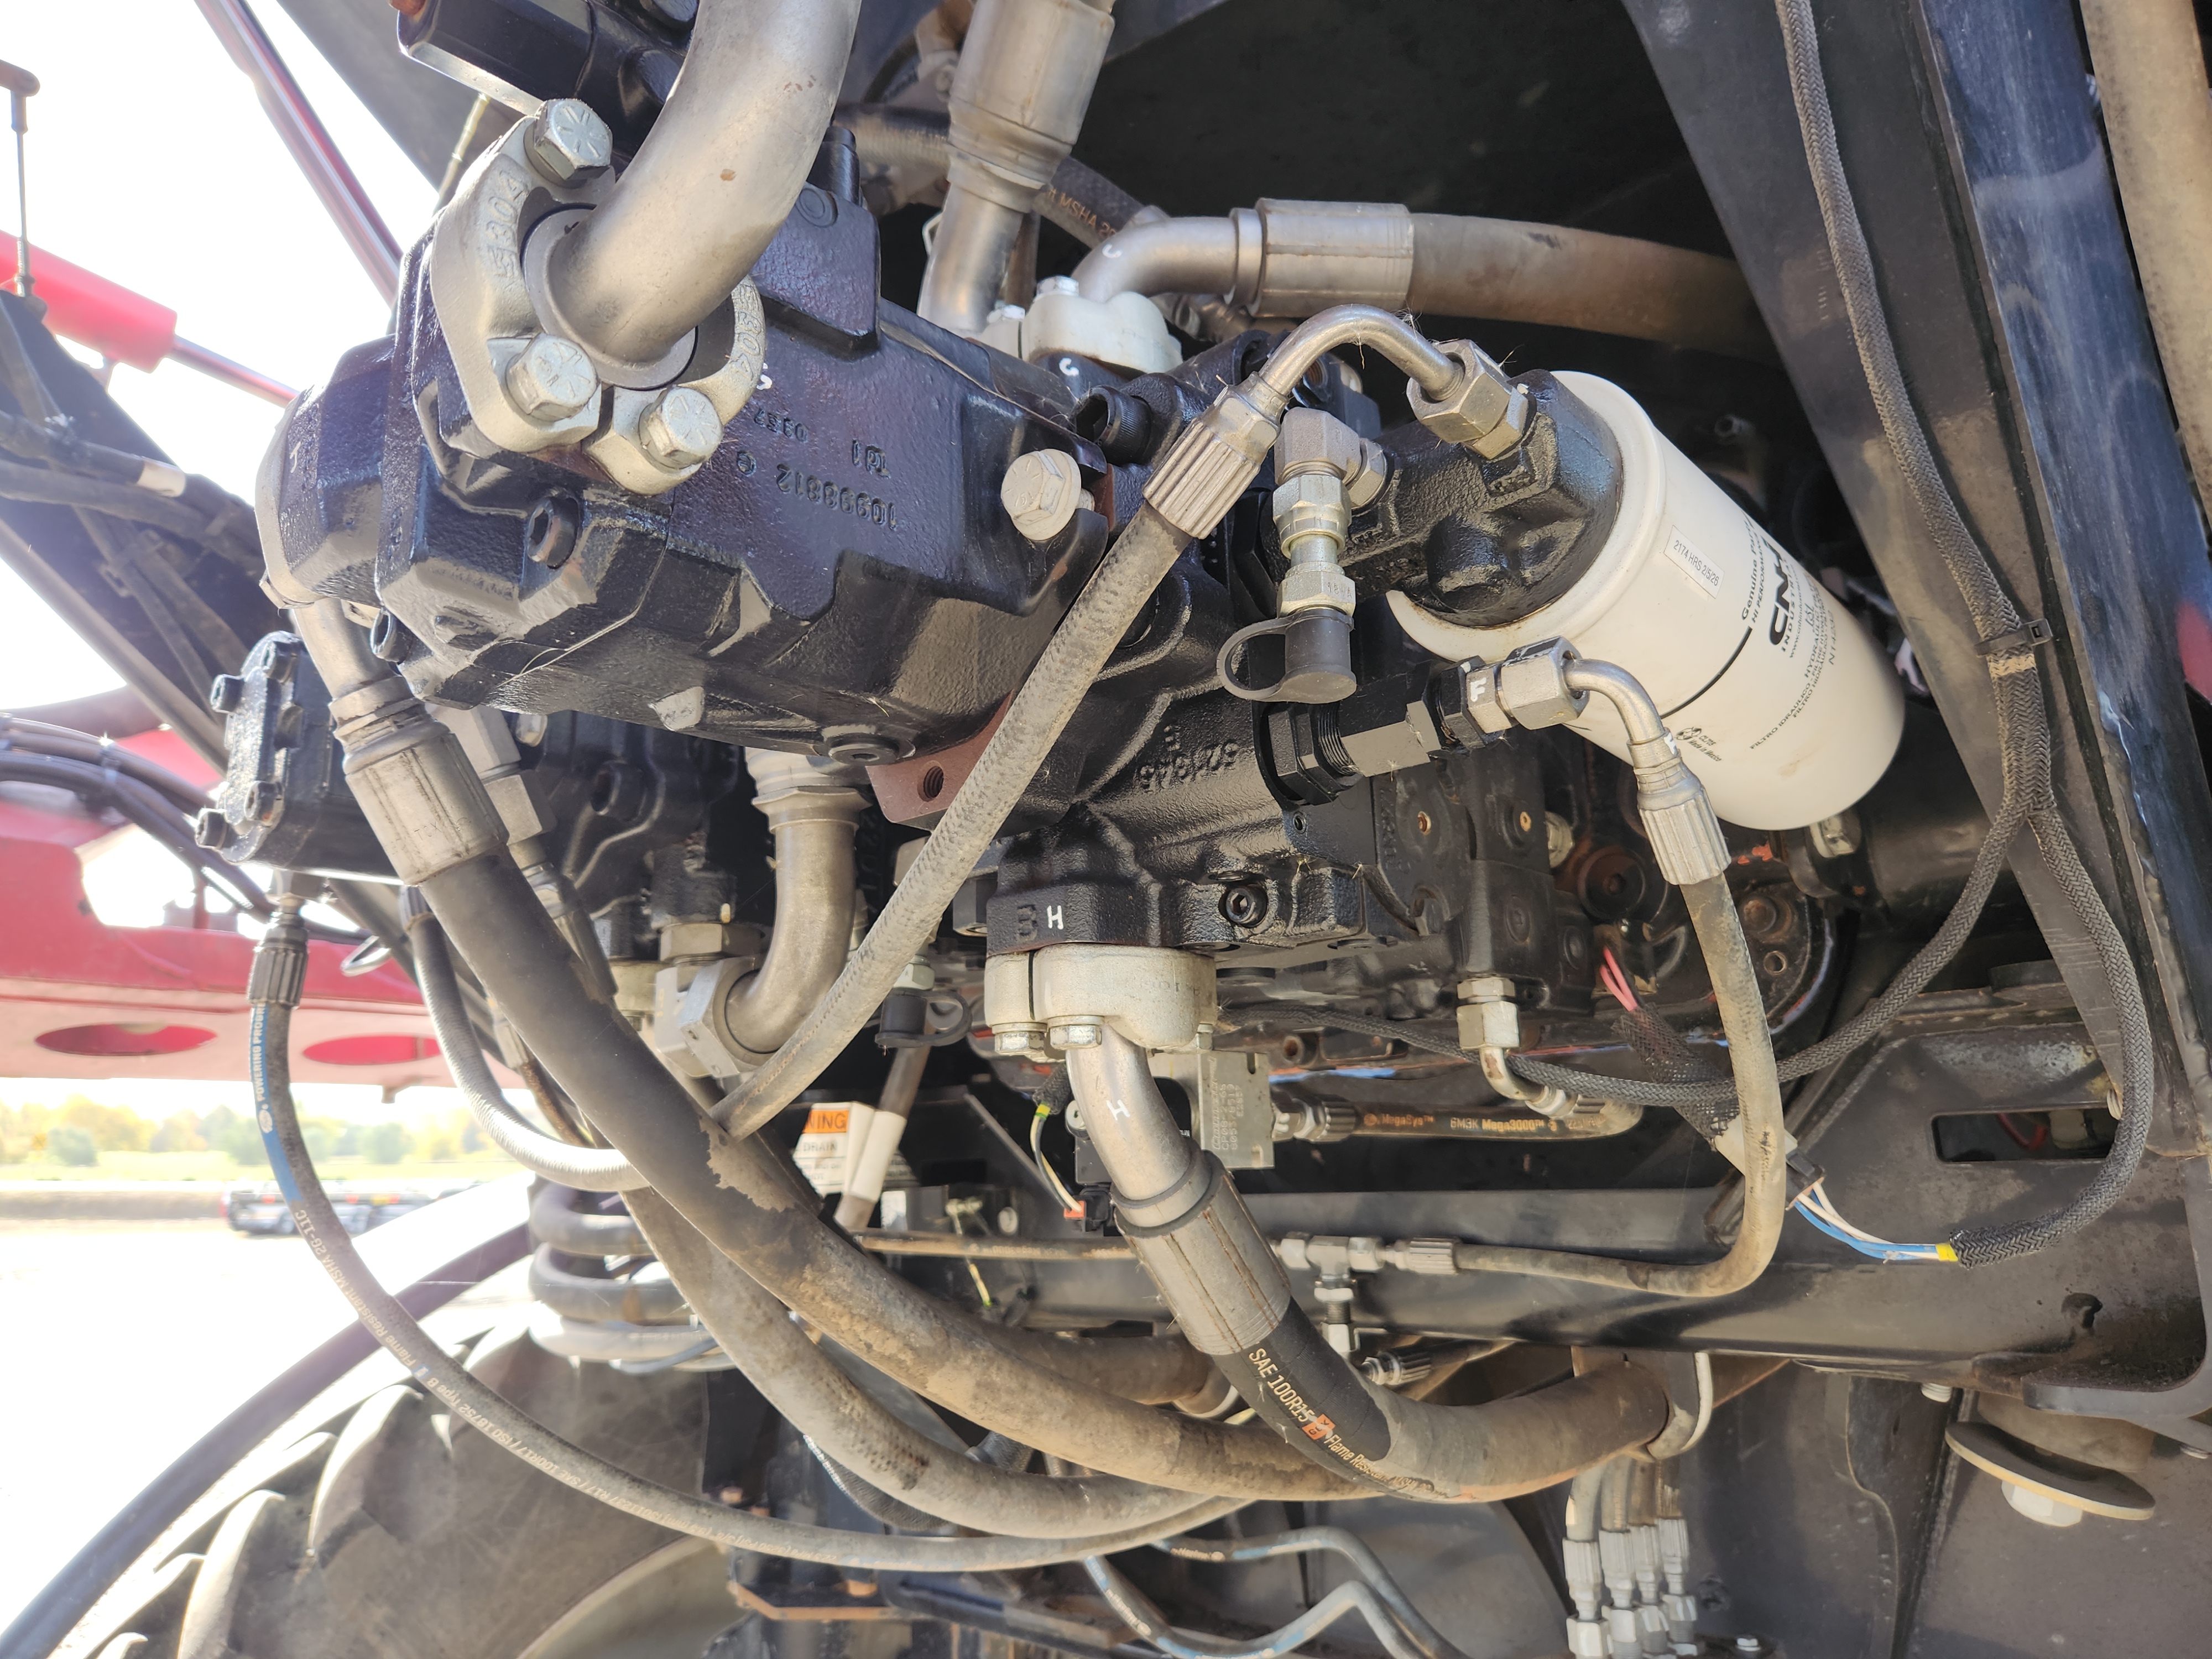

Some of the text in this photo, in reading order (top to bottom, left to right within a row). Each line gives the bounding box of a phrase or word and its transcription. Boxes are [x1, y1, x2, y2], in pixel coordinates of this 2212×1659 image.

[1673, 540, 1720, 586] 2174 HRS 2/5/26
[1741, 559, 1757, 620] Genuine
[1760, 535, 1790, 645] CNH
[1470, 677, 1487, 702] F
[1793, 690, 1813, 718] FILTRO
[1750, 727, 1778, 749] FILTRO
[1778, 683, 1811, 727] IDRAULICO
[1047, 905, 1063, 930] H
[254, 1045, 266, 1101] POWERING
[1107, 1099, 1130, 1120] H
[1450, 1117, 1479, 1130] 6M3K
[294, 1208, 326, 1256] 2G-11C
[320, 1252, 348, 1290] MSHA
[344, 1282, 387, 1340] Resistant
[383, 1335, 415, 1366] Flame
[427, 1376, 439, 1389] B
[436, 1381, 463, 1408] Type
[458, 1399, 494, 1436] 18752
[1249, 1348, 1278, 1378] SAE
[1267, 1376, 1315, 1422] 100R15
[1324, 1434, 1354, 1460] Flame
[492, 1427, 513, 1446] ISO
[515, 1442, 559, 1474] 100R17
[557, 1466, 582, 1488] SAE
